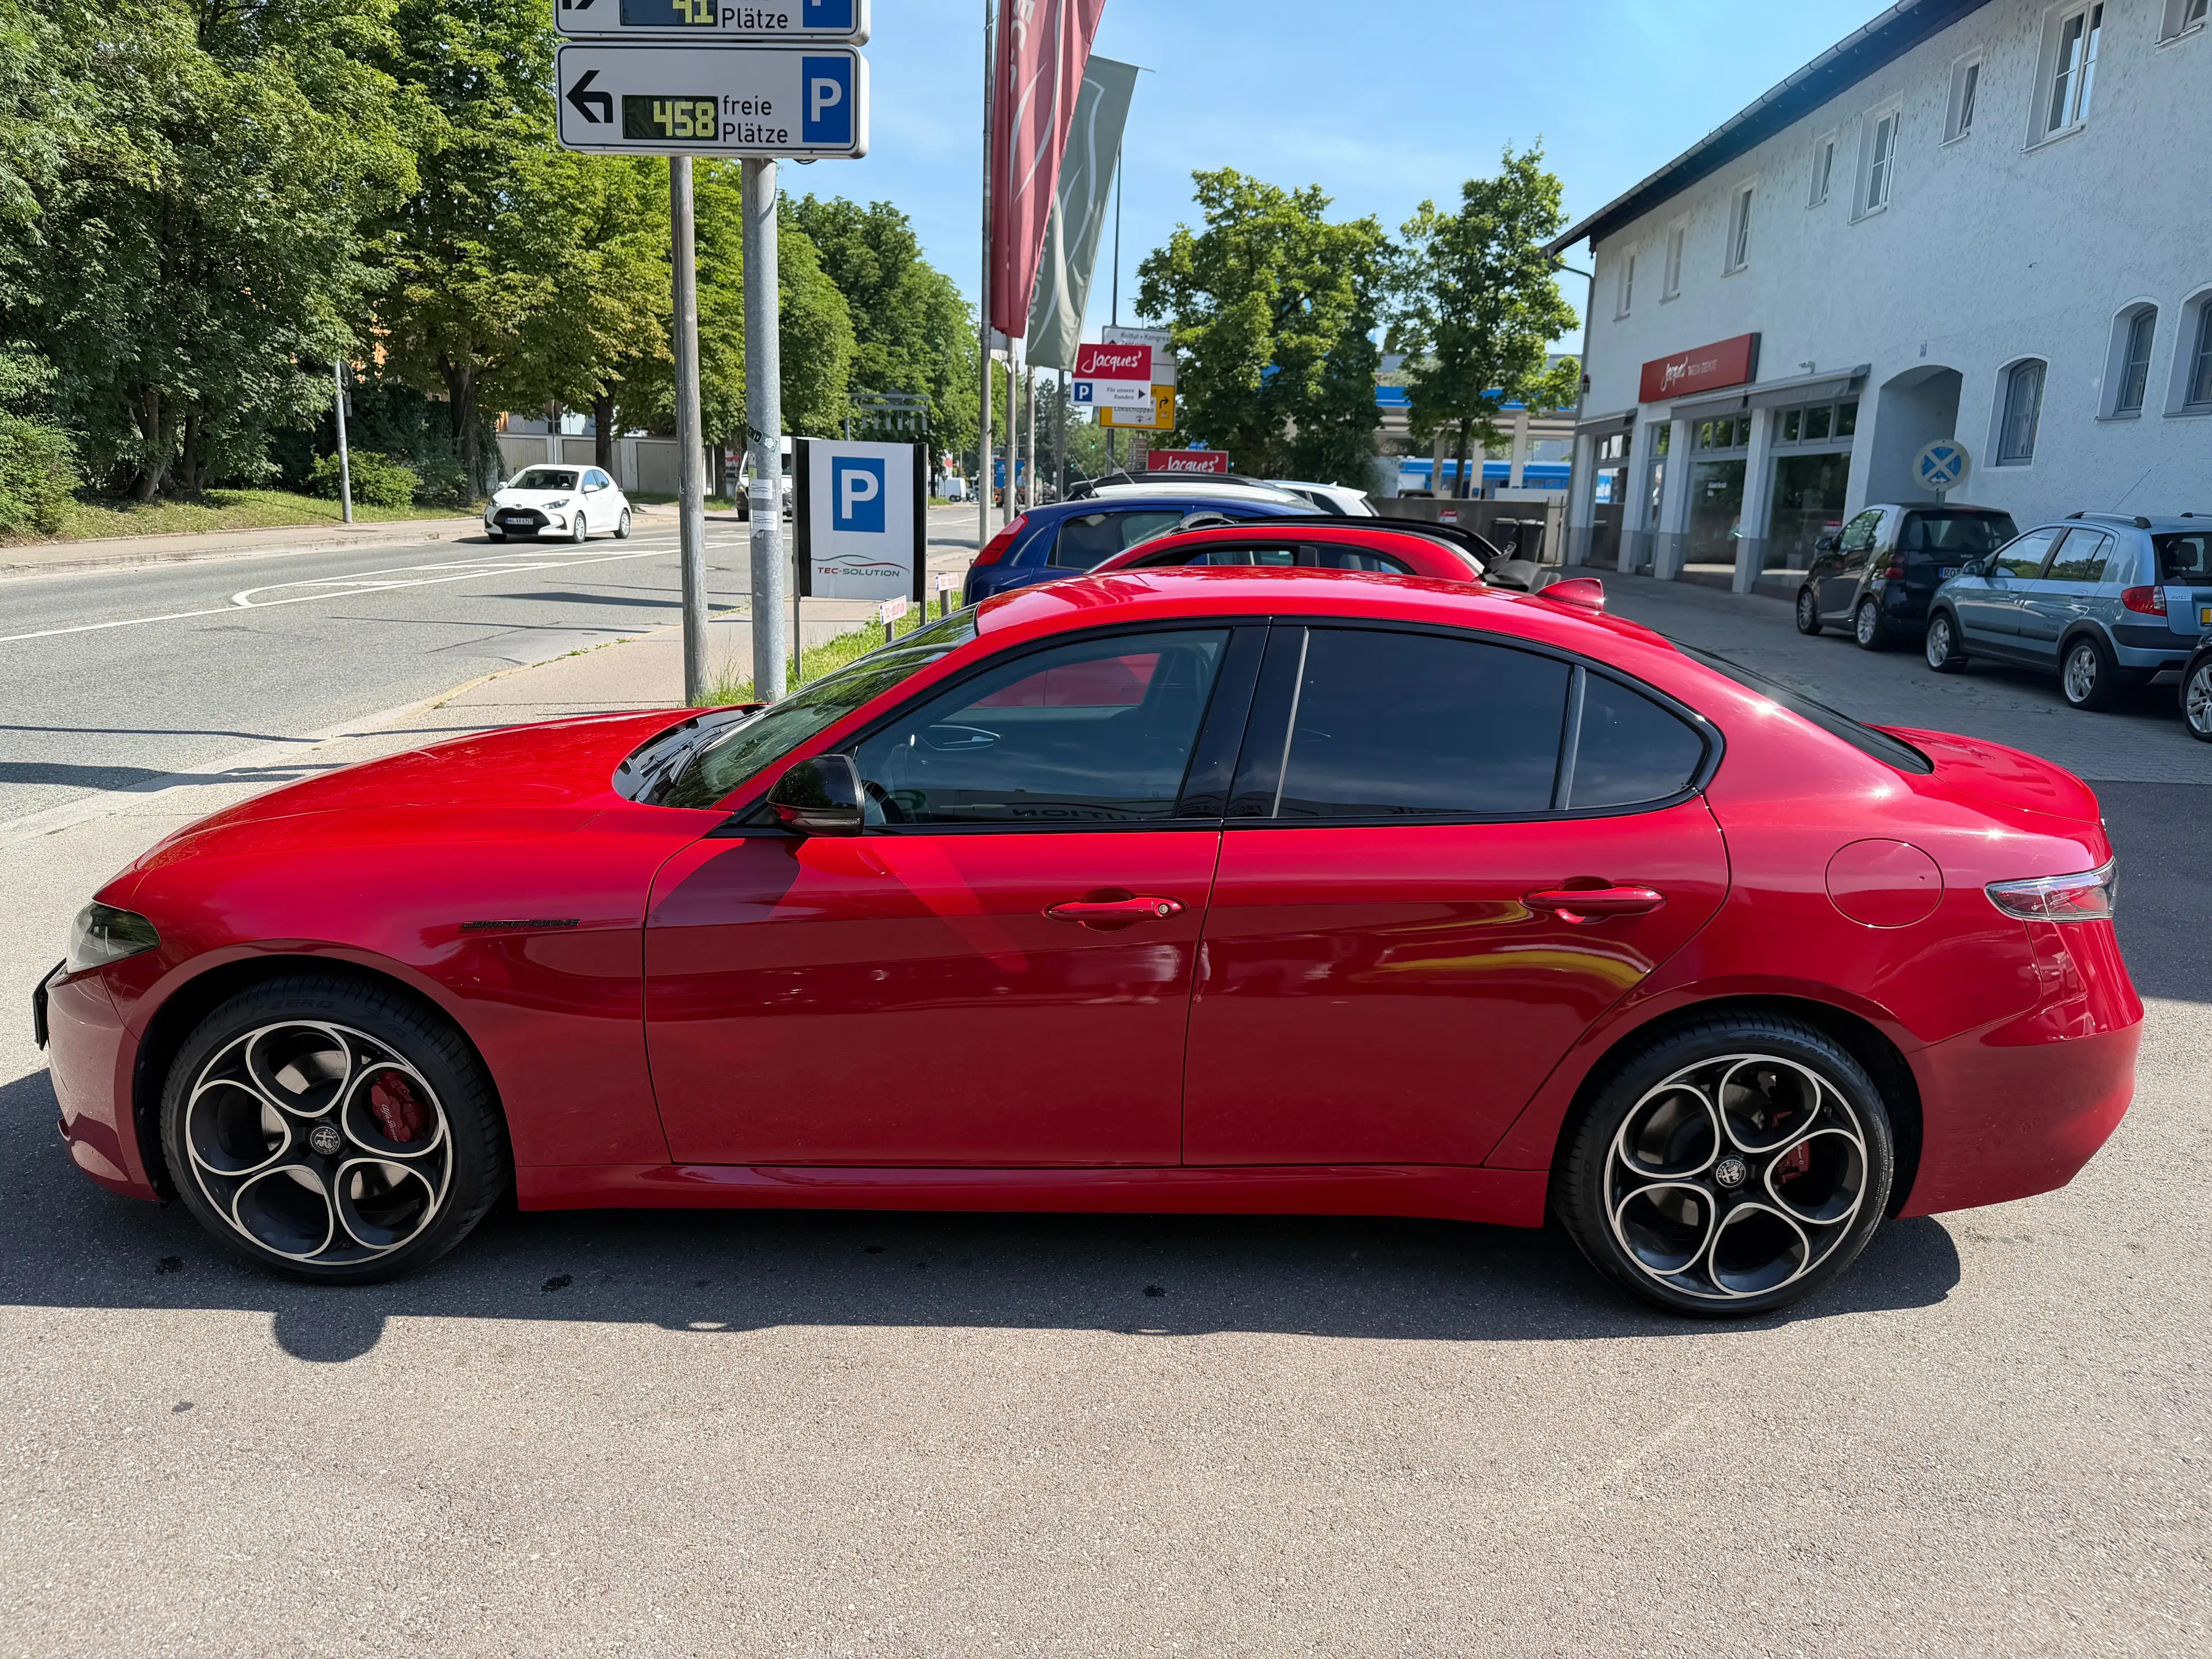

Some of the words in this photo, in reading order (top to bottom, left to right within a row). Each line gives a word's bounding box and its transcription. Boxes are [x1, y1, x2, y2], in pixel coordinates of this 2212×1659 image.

[722, 7, 788, 29] Plätze
[723, 96, 772, 115] freie
[811, 78, 842, 122] P
[653, 101, 715, 137] 458
[722, 123, 788, 143] Plätze
[1079, 385, 1089, 400] P
[841, 469, 879, 519] P
[817, 567, 900, 577] TEC-SOLUTION
